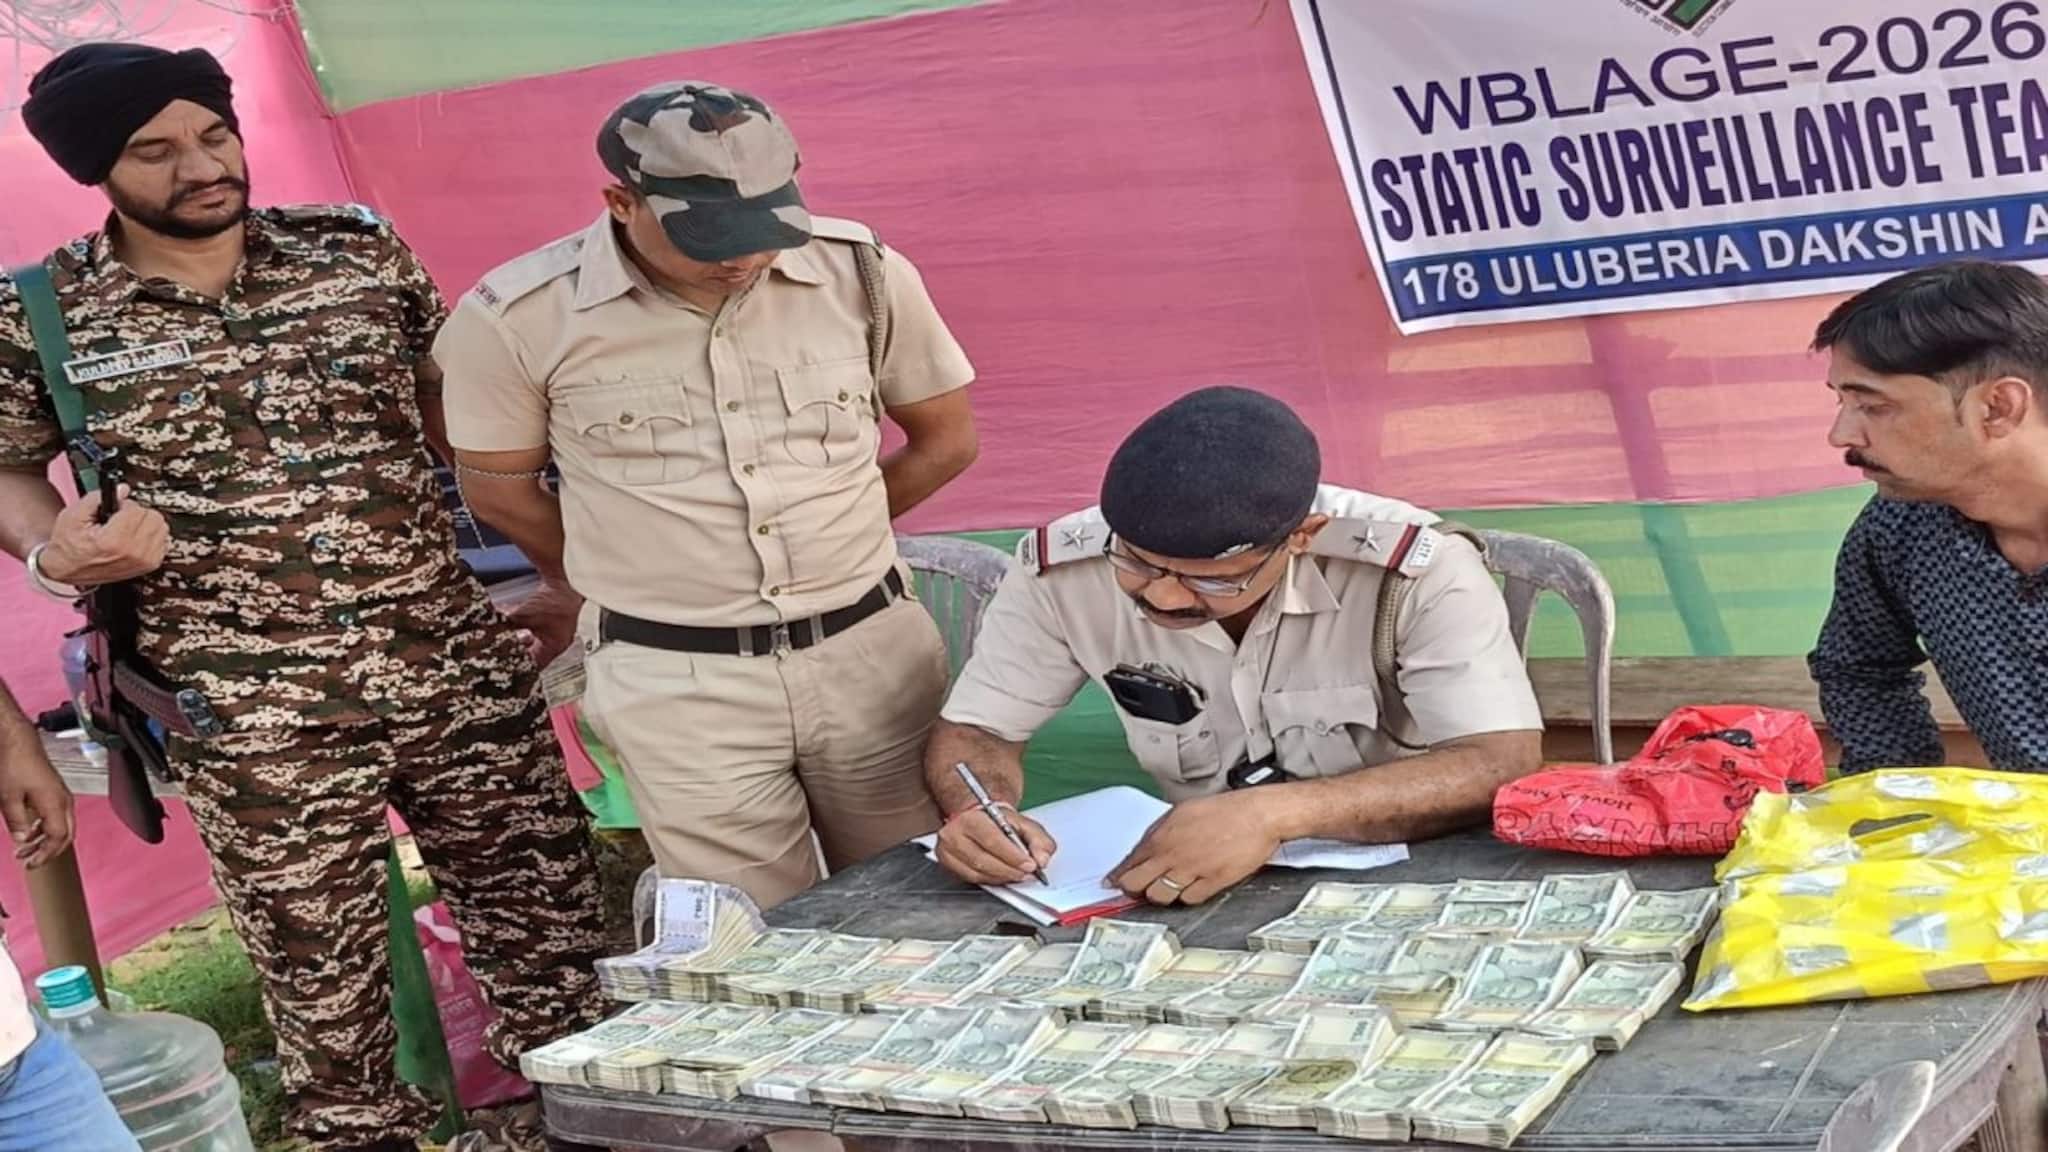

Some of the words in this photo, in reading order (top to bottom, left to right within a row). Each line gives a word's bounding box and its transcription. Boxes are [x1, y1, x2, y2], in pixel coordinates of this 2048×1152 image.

[1392, 1, 2046, 136] WBLAGE-2026
[1371, 141, 1542, 242] STATIC
[1549, 92, 1943, 222] SURVEILLANCE
[1948, 78, 2048, 179] TEA
[1403, 261, 1480, 305] 178
[1490, 234, 1750, 295] ULUBERIA
[1758, 207, 2004, 269] DAKSHIN
